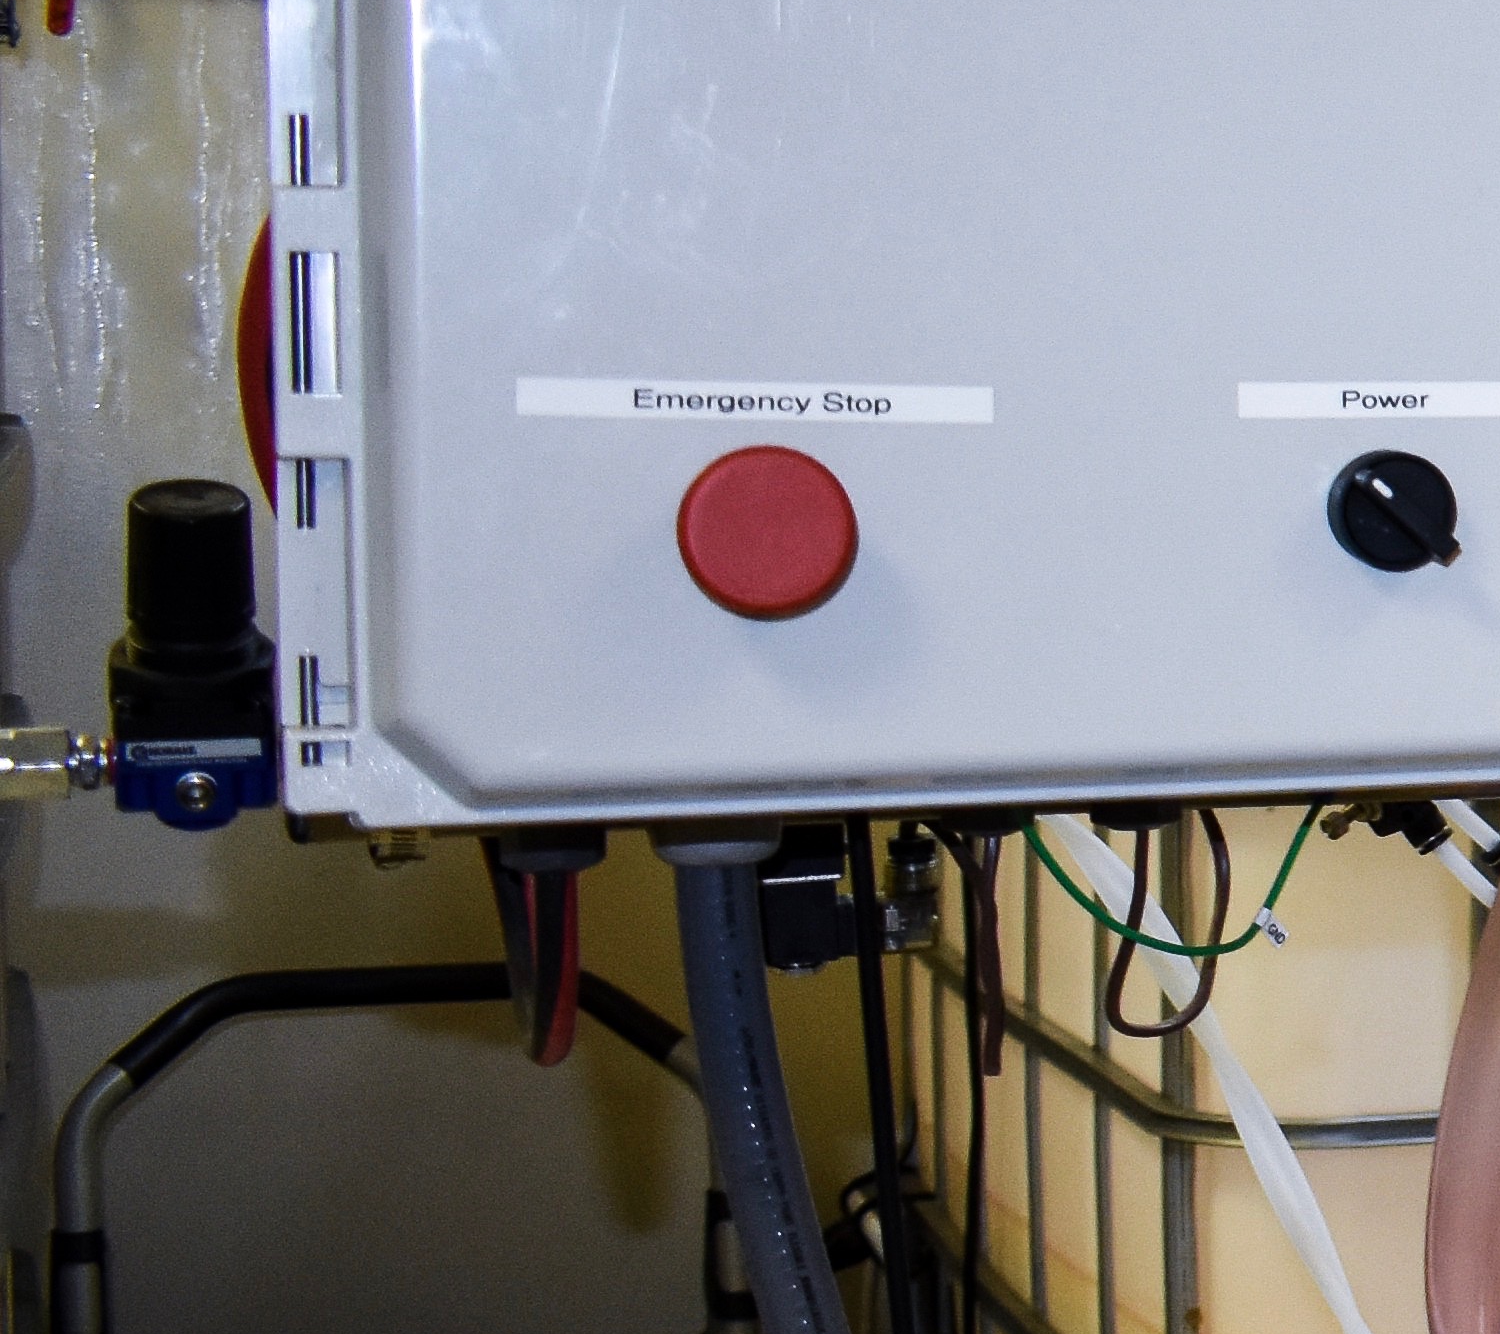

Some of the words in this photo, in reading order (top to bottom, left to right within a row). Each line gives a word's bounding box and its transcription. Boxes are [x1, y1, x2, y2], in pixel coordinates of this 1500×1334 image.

[633, 388, 811, 416] Emergency
[823, 388, 891, 416] Stop
[1340, 388, 1428, 411] Power
